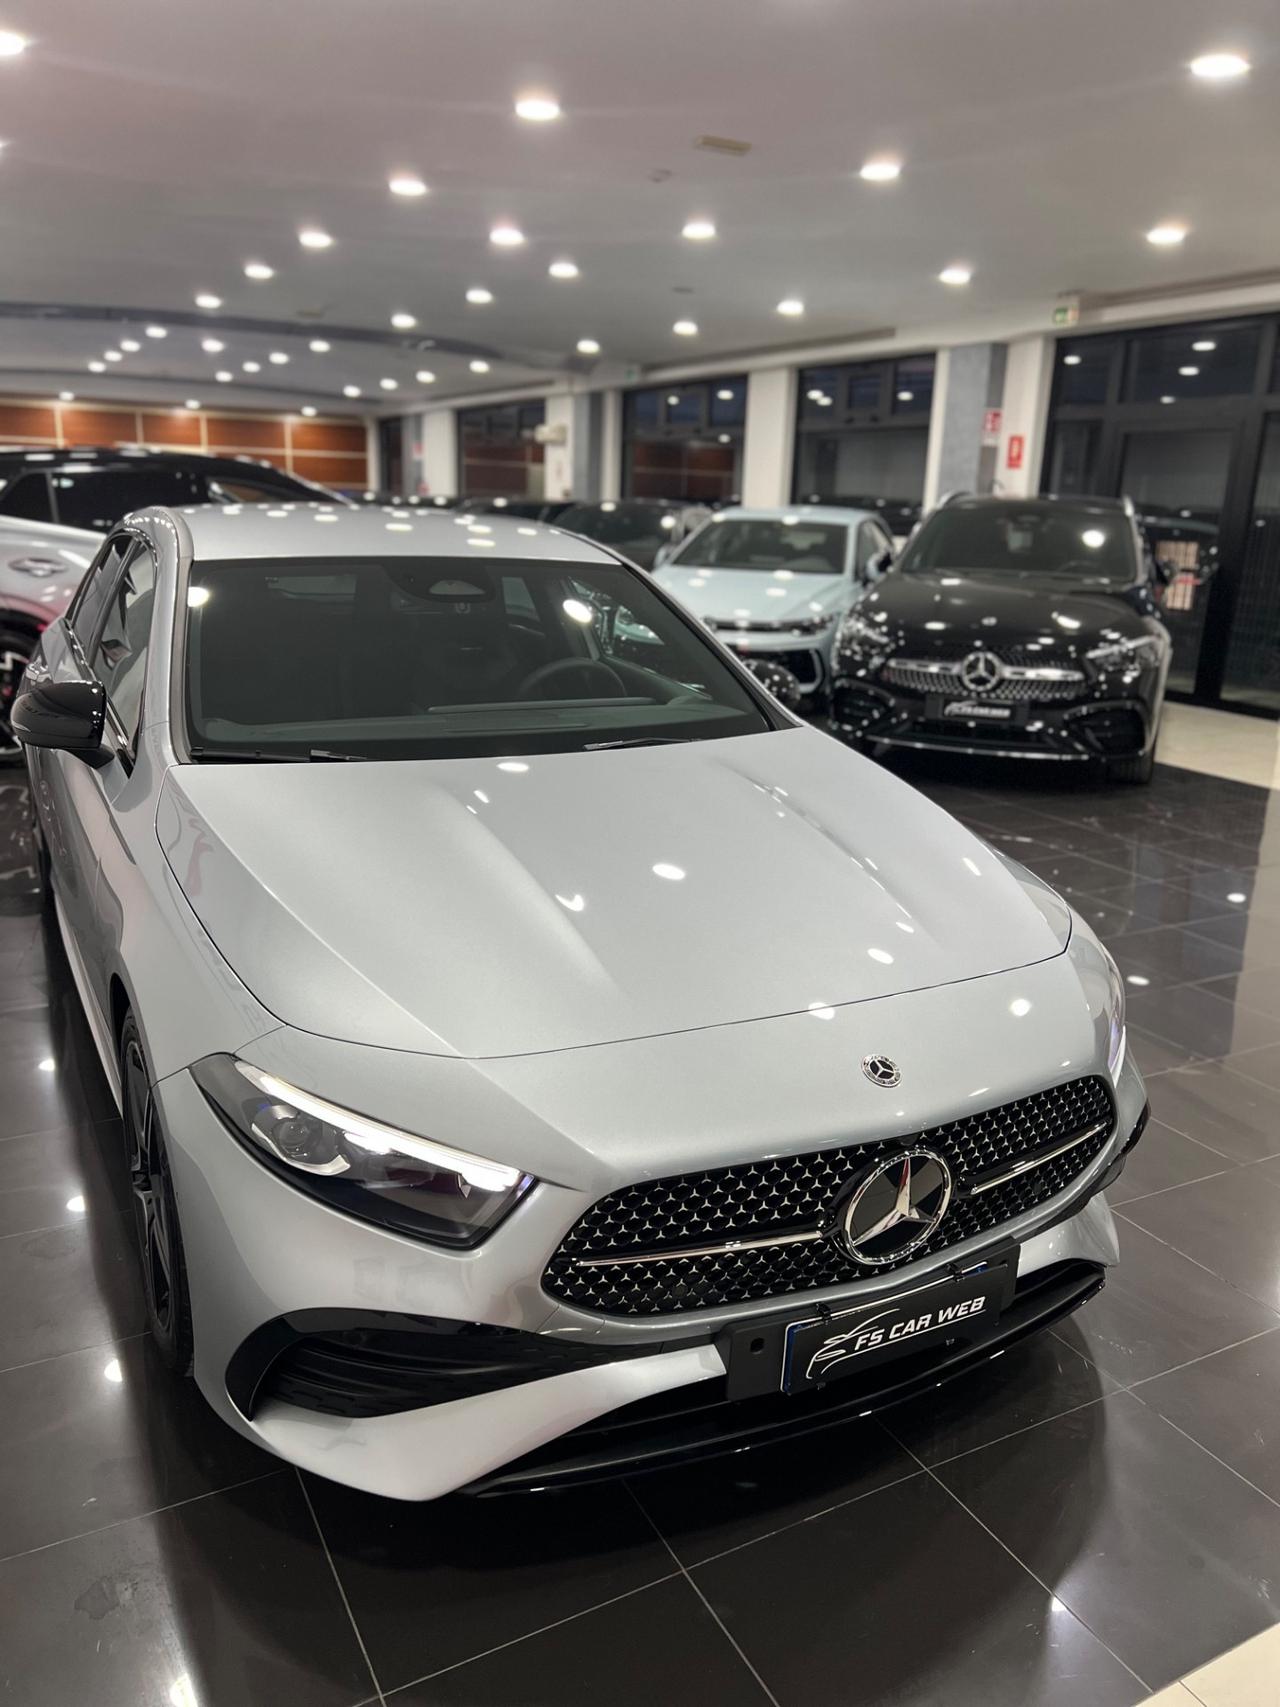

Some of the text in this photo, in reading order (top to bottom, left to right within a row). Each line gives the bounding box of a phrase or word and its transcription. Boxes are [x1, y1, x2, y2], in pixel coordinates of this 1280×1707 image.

[854, 1296, 986, 1351] FS CAR WEB
